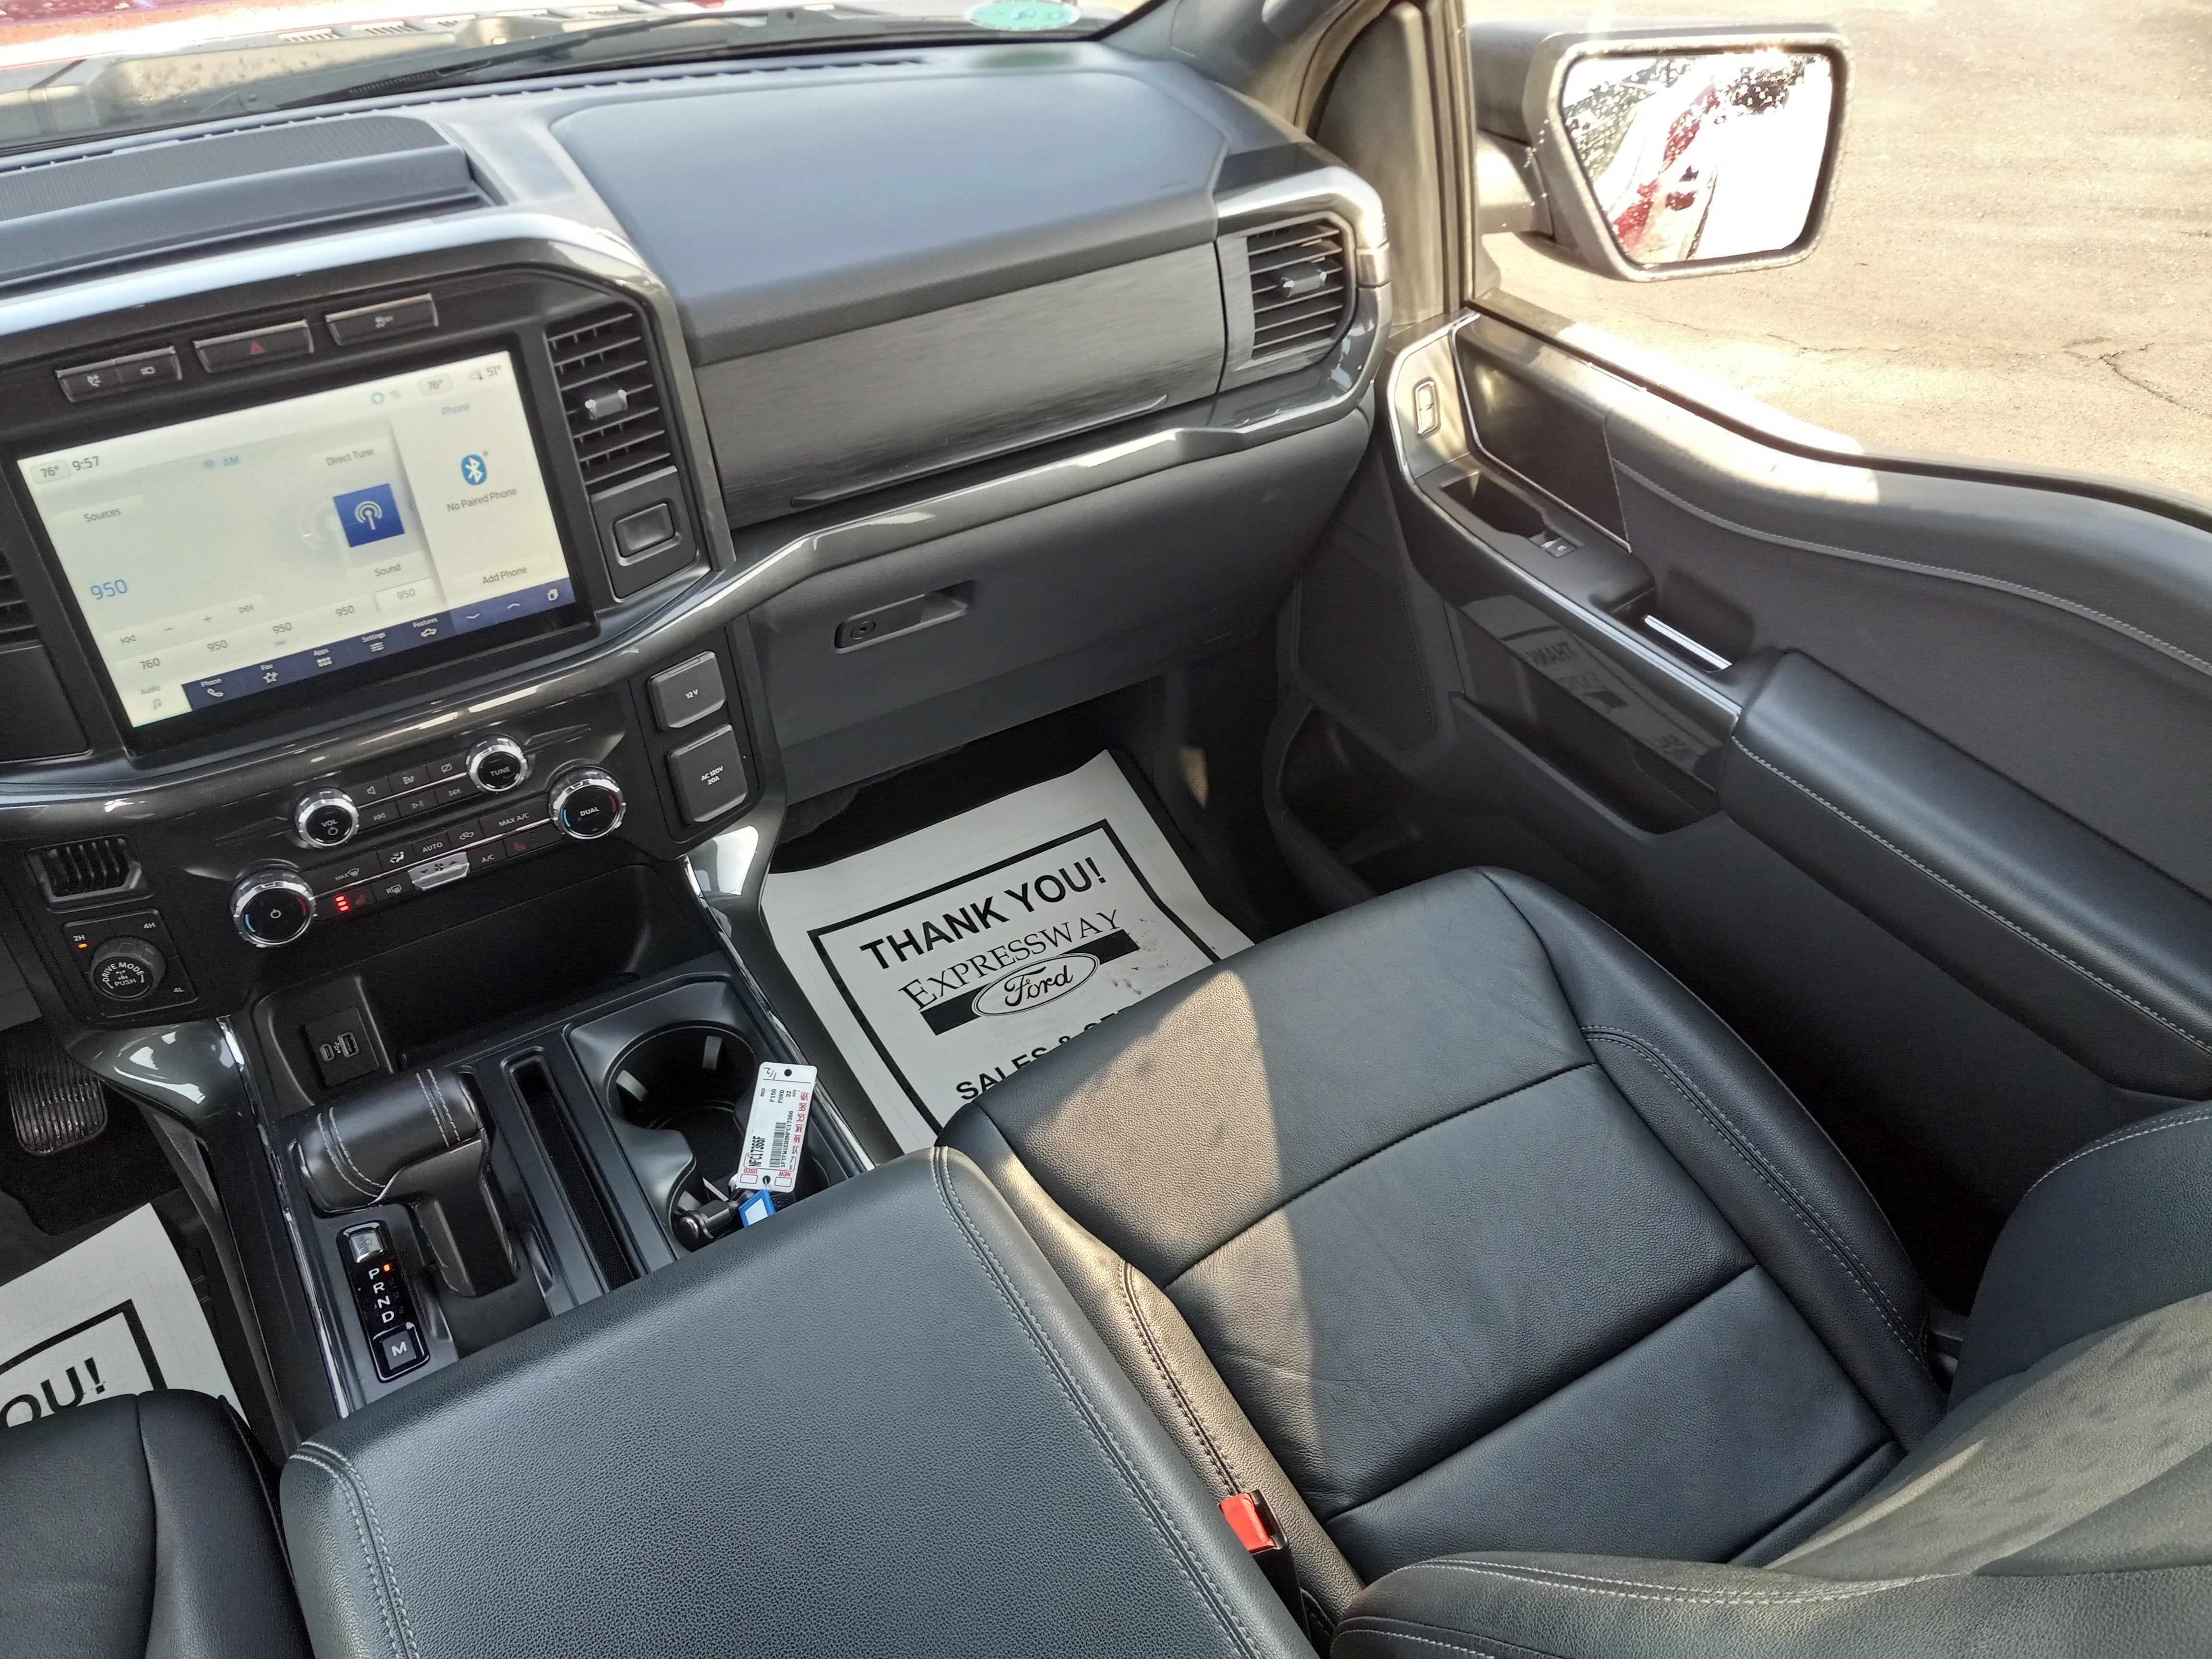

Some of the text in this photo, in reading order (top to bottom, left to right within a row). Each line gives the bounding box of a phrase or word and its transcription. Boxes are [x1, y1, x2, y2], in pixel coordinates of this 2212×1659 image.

[442, 402, 470, 416] Phone
[72, 456, 100, 471] 9:57
[223, 455, 240, 467] AM
[326, 447, 374, 467] Direct Tune
[447, 487, 517, 512] No Paired Phone
[84, 506, 121, 524] Sources
[374, 563, 401, 577] Sound
[482, 565, 528, 585] Add Phone
[90, 579, 128, 600] 950
[140, 588, 416, 670] 760 950 950 950 950
[361, 632, 386, 643] Settings
[413, 617, 438, 628] Features
[490, 767, 511, 777] TUNE
[701, 766, 723, 781] AC 120V
[707, 775, 720, 785] 20A
[580, 806, 600, 817] DUAL
[321, 819, 338, 828] VOL
[499, 813, 529, 827] MAX A/C
[422, 842, 443, 853] AUTO
[481, 854, 495, 864] A/C
[335, 872, 349, 881] MAX
[860, 856, 1107, 970] THANK YOU!
[898, 909, 1123, 1011] EXPRESSWAY
[102, 962, 145, 983] DRIVE MODE
[114, 978, 136, 987] PUSH
[1003, 965, 1074, 1008] Ford
[748, 1136, 766, 1166] NFC17366F
[369, 1268, 380, 1279] P
[373, 1282, 385, 1294] R
[377, 1296, 391, 1309] N
[382, 1311, 395, 1323] D
[391, 1341, 407, 1356] M
